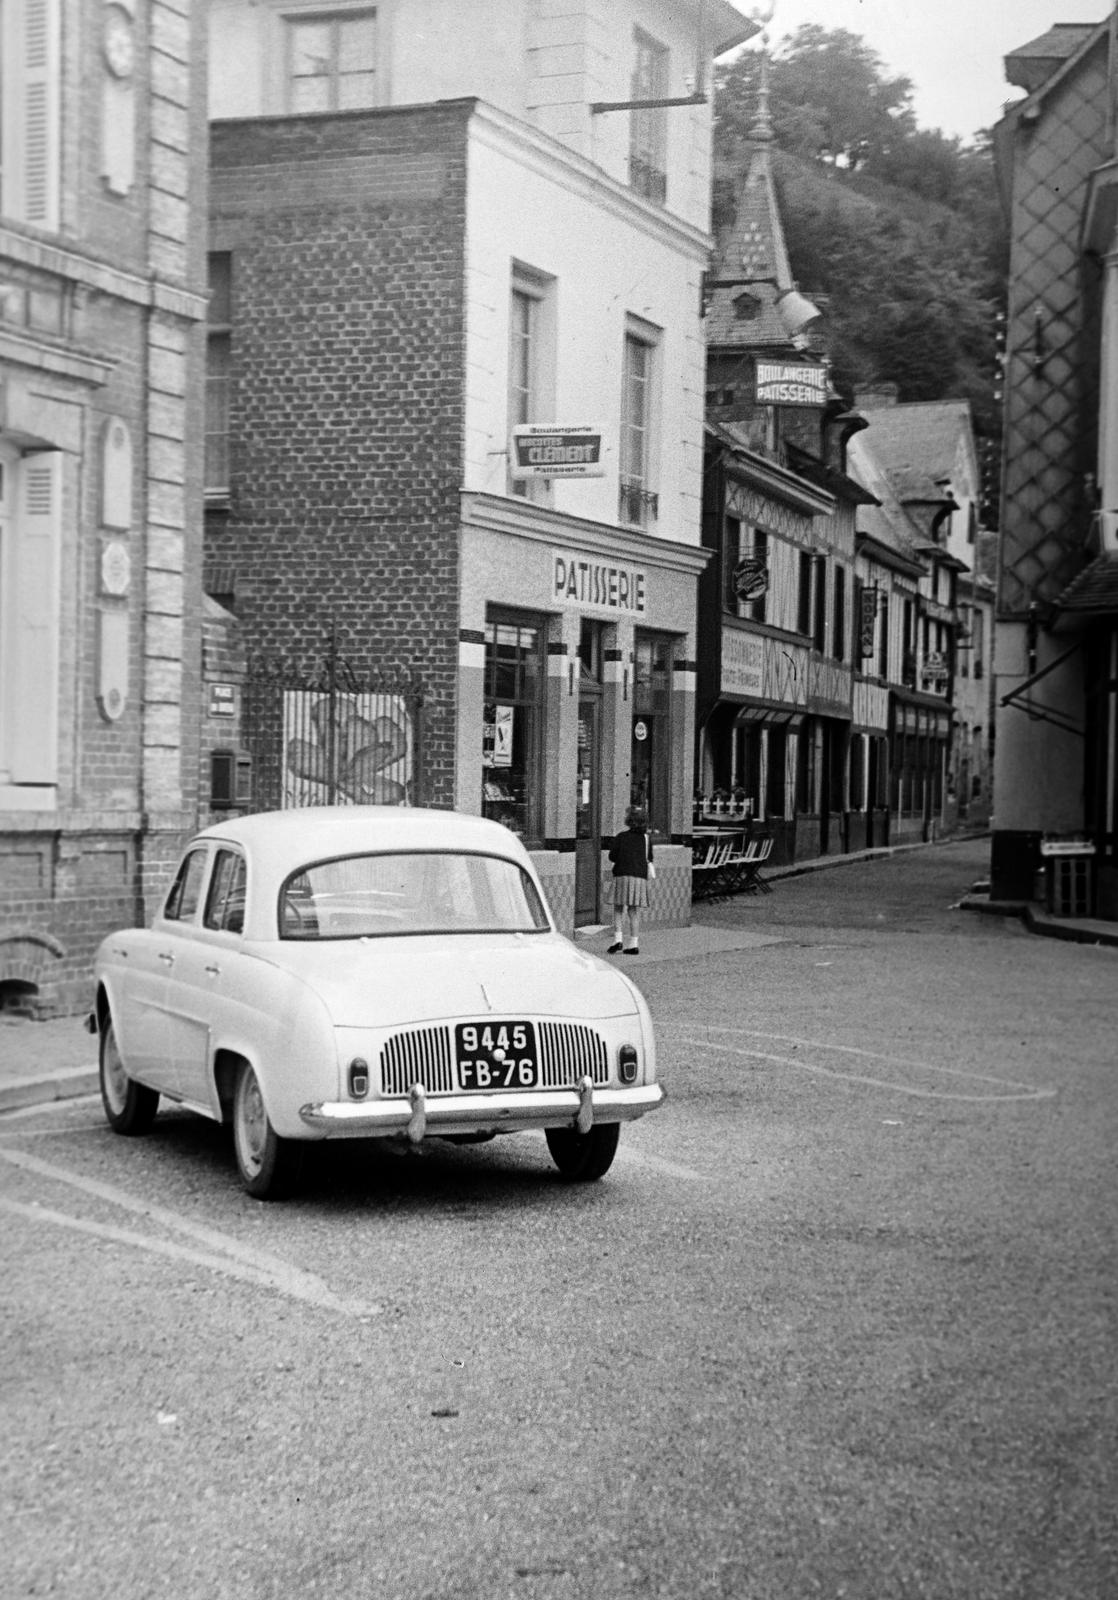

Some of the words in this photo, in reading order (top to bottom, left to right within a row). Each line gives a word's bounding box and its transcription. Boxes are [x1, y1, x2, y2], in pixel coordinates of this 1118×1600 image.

[757, 365, 827, 389] BOULANGERIE
[555, 557, 644, 612] PATISSERIE
[462, 1026, 527, 1051] 9445
[459, 1058, 534, 1086] FB-76
